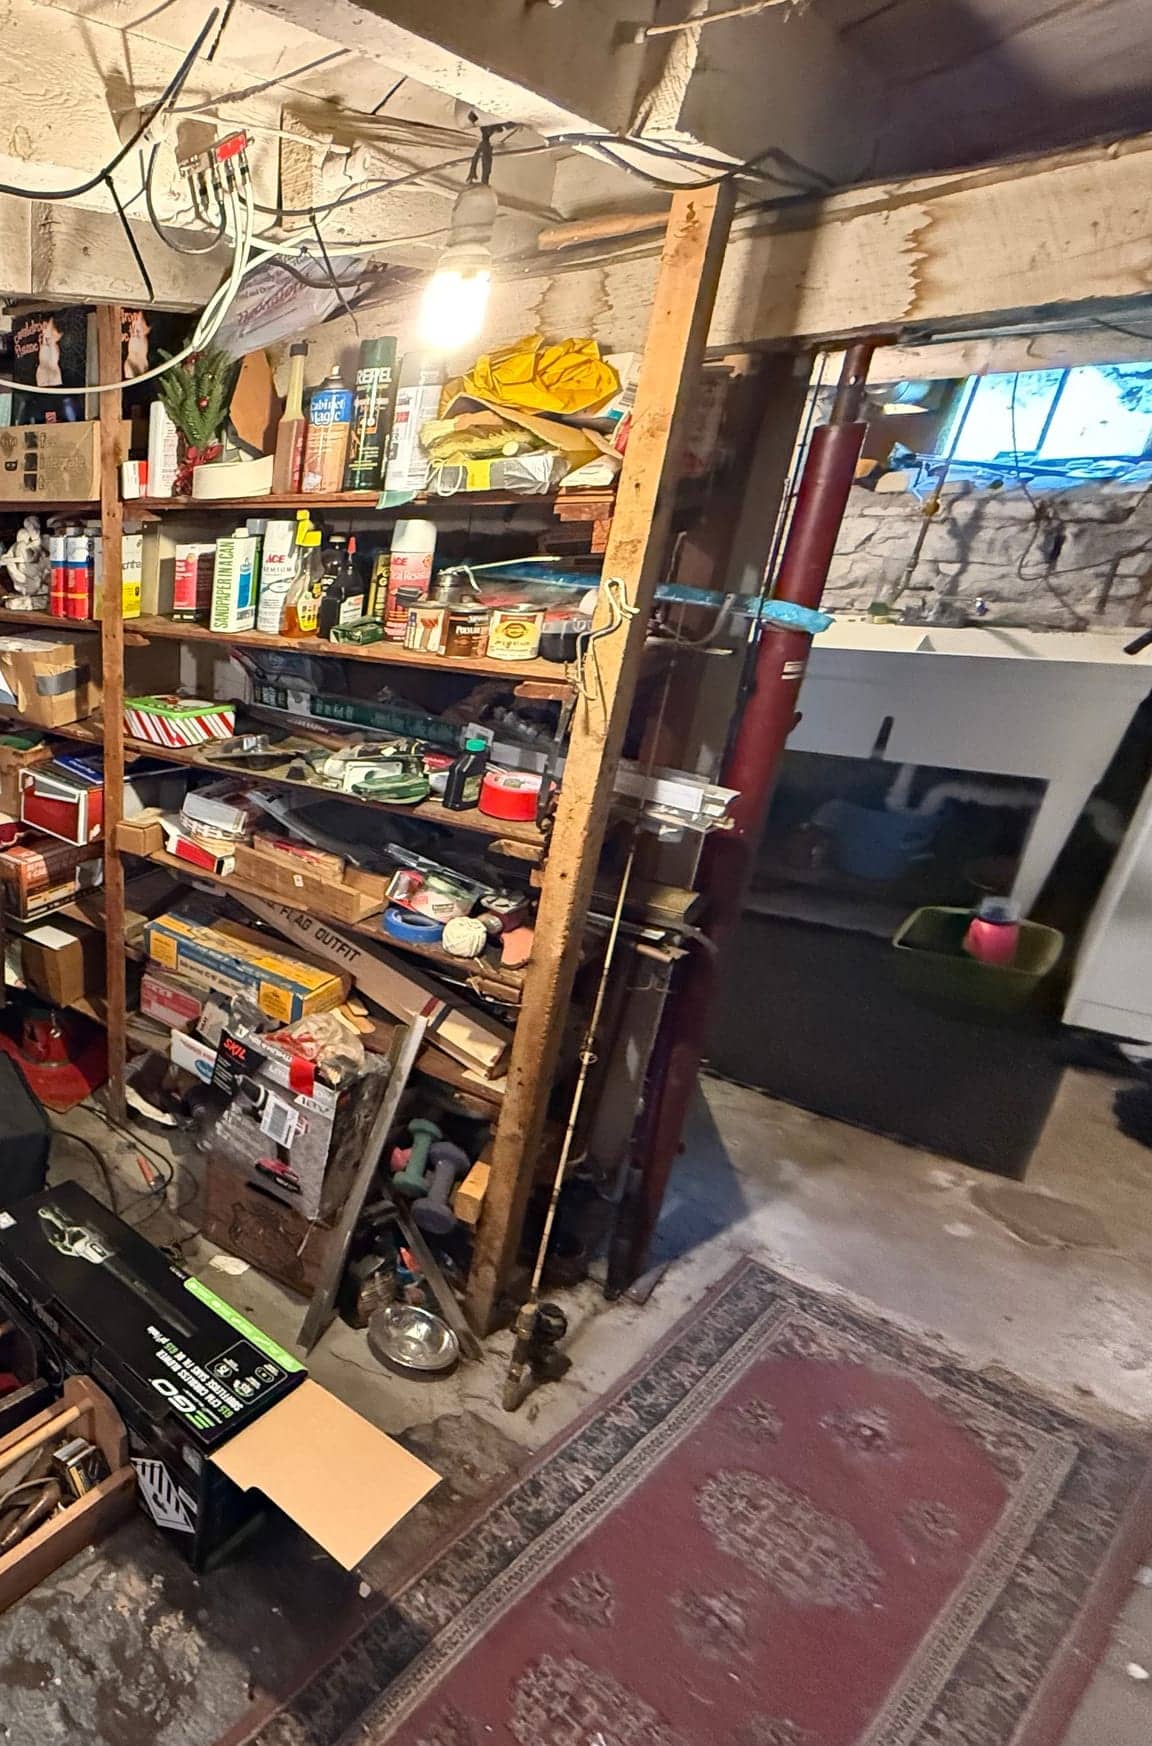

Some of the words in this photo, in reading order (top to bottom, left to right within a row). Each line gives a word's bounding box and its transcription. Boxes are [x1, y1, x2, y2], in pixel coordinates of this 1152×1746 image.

[356, 367, 392, 384] REPEL
[218, 541, 235, 560] CAN
[265, 554, 285, 564] ACE
[218, 567, 233, 577] IN
[214, 579, 232, 629] SANDPAPER
[280, 905, 311, 931] FLAG
[314, 926, 362, 962] OUTFIT
[223, 1038, 247, 1061] SKIL
[149, 1378, 217, 1430] EGO
